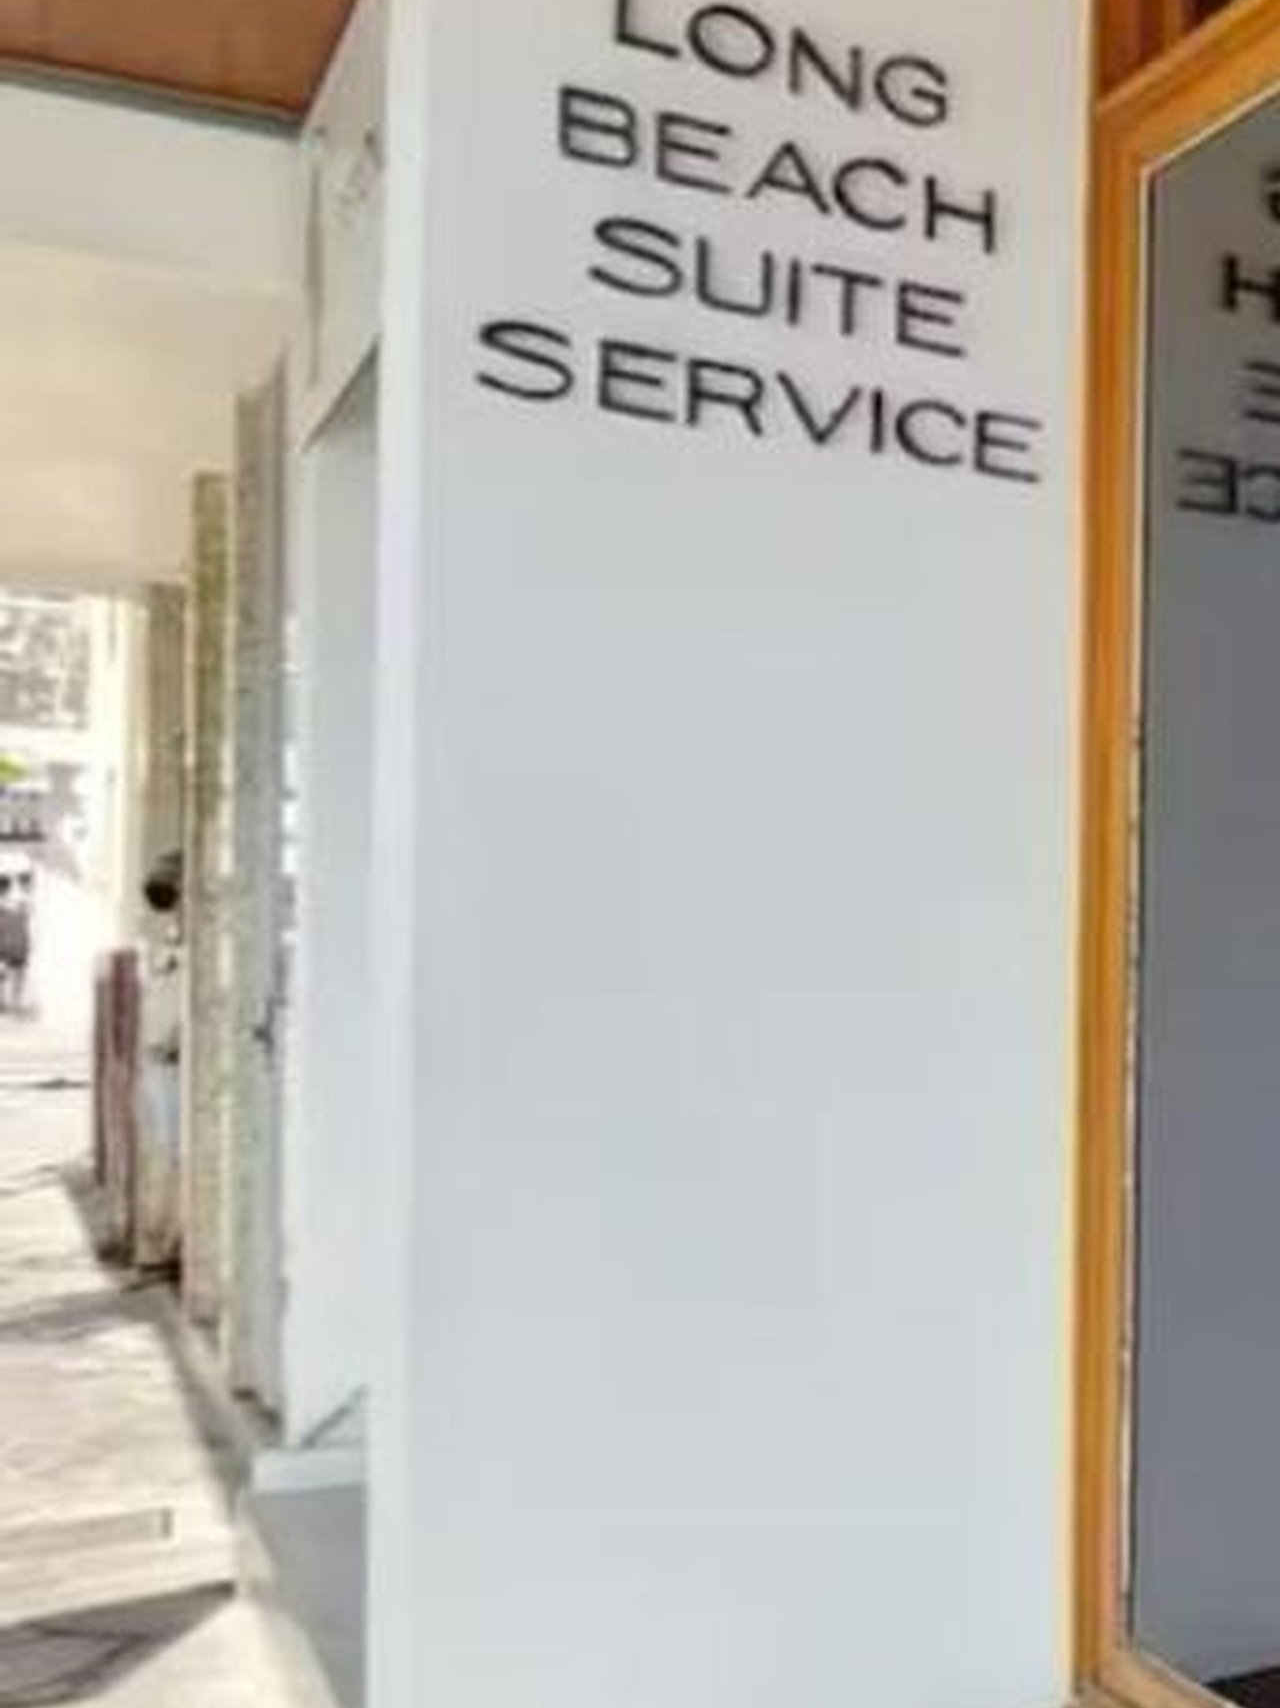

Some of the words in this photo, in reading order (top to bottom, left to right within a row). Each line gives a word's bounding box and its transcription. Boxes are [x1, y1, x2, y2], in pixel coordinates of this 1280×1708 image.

[558, 86, 997, 255] BEACH
[588, 217, 968, 359] SUITE
[476, 320, 1044, 484] SERVICE
